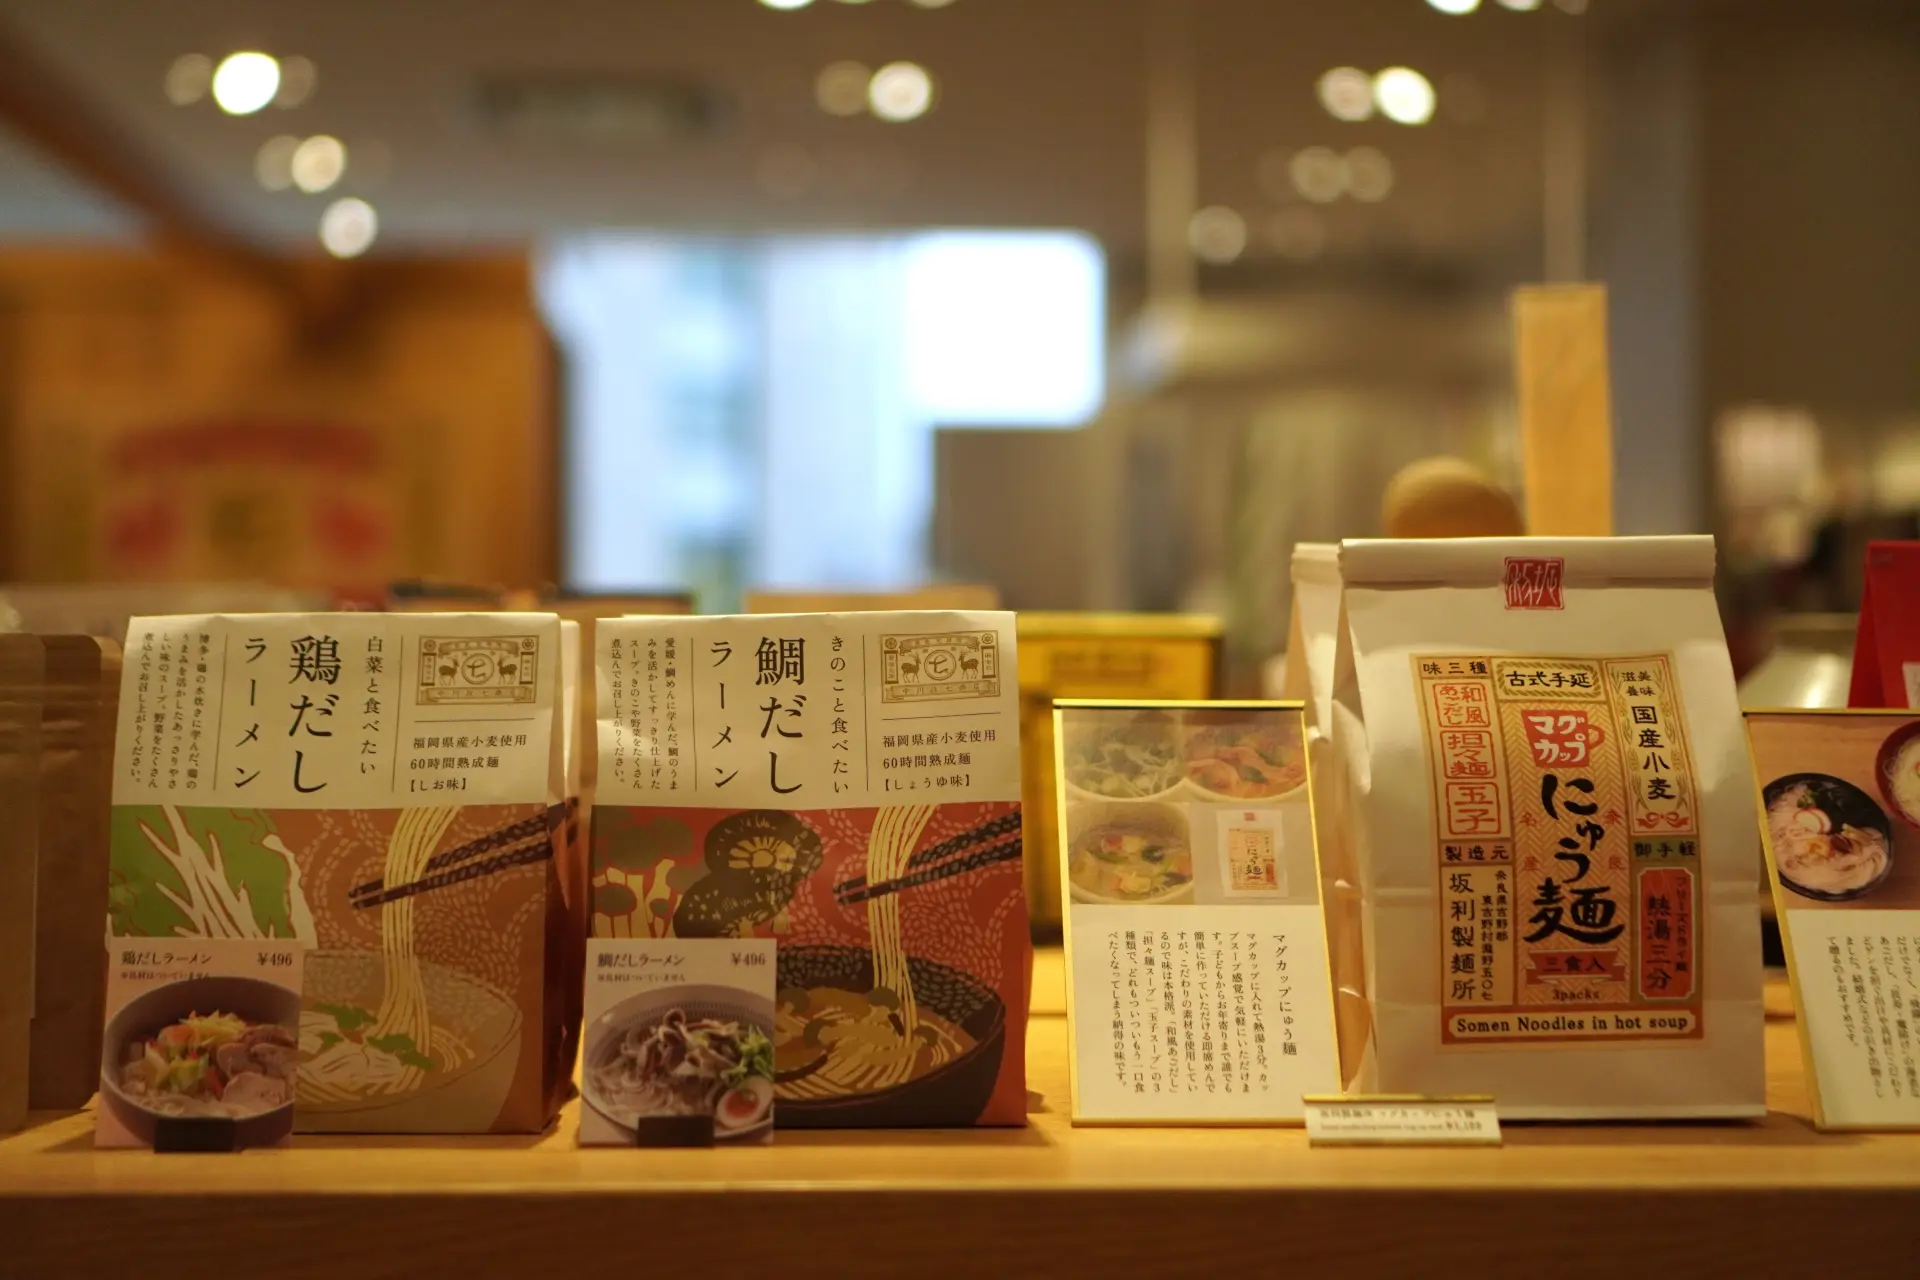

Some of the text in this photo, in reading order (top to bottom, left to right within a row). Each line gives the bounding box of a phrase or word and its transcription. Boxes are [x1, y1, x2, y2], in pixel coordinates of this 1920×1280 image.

[1422, 661, 1488, 675] 味三種
[1505, 671, 1593, 689] 古式手延
[234, 637, 268, 789] ラーメン
[288, 634, 344, 793] 鶏だし
[360, 636, 384, 776] 白菜と食べたい
[646, 638, 662, 790] みを活かしてすっきり仕上げた
[710, 640, 739, 788] ラーメン
[754, 636, 807, 795] 鯛だし
[829, 636, 849, 794] きのこと食べたい
[1440, 686, 1463, 725] あごだし
[1461, 686, 1486, 724] 和風
[413, 734, 528, 750] 福岡県産小麦使用
[882, 730, 996, 749] 福岡県産小麦使用
[1448, 734, 1492, 777] 担々麺
[1631, 706, 1676, 800] 国産小麦
[410, 756, 500, 770] 60時間熟成麺
[883, 752, 971, 769] 60時間熟成麺
[409, 778, 467, 793] 【しお味】
[884, 775, 971, 792] 【しょうゆ味】
[1454, 786, 1497, 831] 玉子
[1445, 845, 1509, 861] 製造元
[1522, 773, 1625, 944] にゅう麺
[1633, 841, 1697, 858] 御手軽
[1494, 870, 1509, 942] 奈良県吉野郡
[1449, 873, 1476, 1000] 坂利製麺所
[1646, 895, 1673, 990] 熱湯三分
[121, 951, 213, 967] 鶏だしラーメン
[597, 953, 686, 968] 鯛だしラーメン
[1544, 955, 1606, 973] 三食入
[1272, 933, 1298, 1057] マグカップにゅう麺
[1457, 1015, 1689, 1032] Somen Noodles in hot soup
